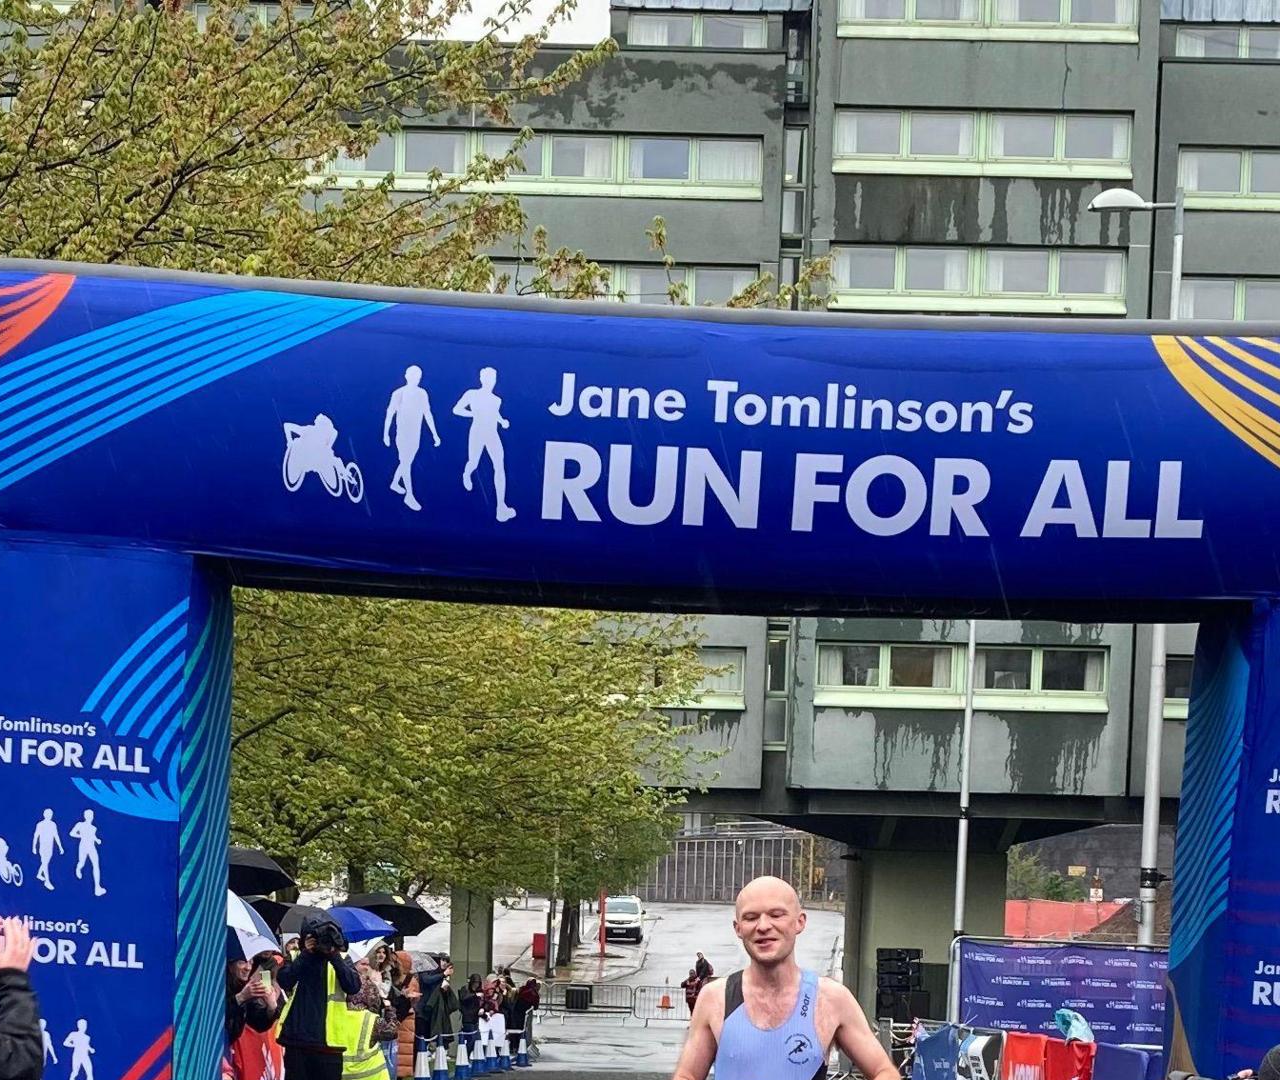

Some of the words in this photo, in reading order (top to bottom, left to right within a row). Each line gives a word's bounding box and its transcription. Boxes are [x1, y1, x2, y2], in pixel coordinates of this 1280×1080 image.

[547, 371, 686, 422] Jane
[707, 379, 1034, 435] Tomlinson's
[541, 440, 763, 529] RUN
[791, 452, 991, 537] FOR
[1019, 459, 1205, 539] ALL
[20, 739, 84, 769] FOR
[92, 744, 151, 774] ALL
[32, 937, 77, 965] OR
[85, 940, 144, 970] ALL
[800, 993, 811, 1018] soar
